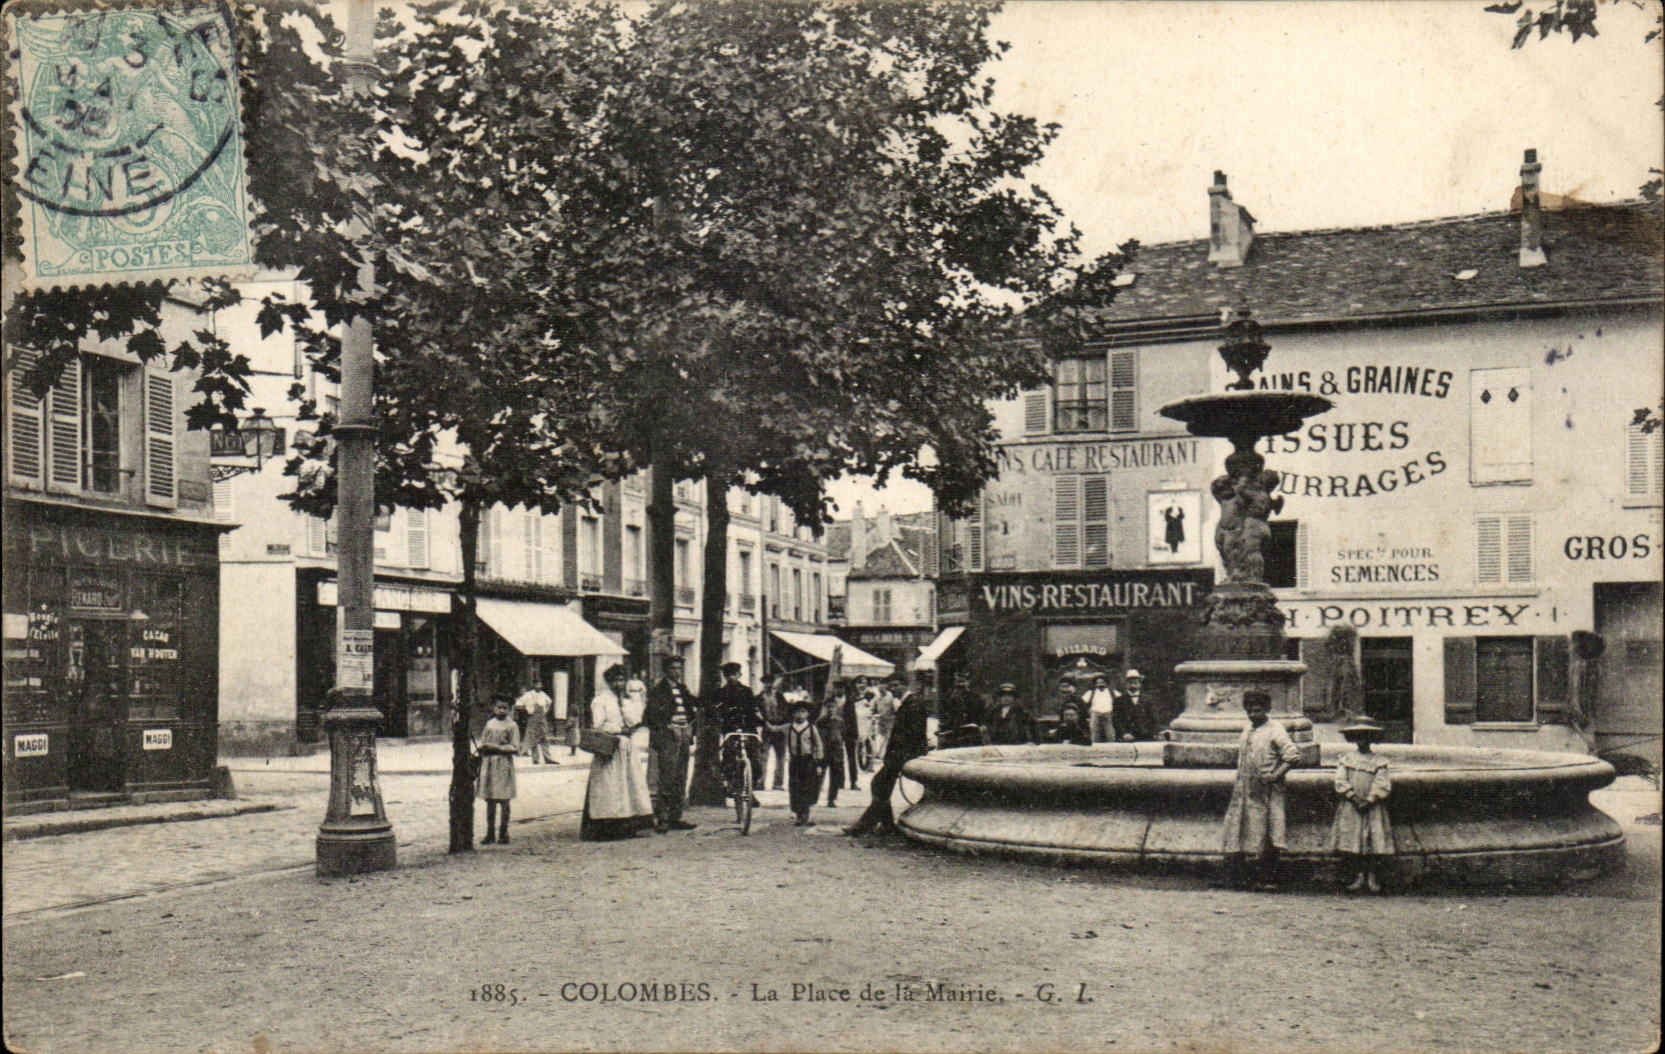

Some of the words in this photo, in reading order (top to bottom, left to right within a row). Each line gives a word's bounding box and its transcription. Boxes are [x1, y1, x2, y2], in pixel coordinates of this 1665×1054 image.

[96, 242, 187, 269] POSTES
[1320, 371, 1341, 395] &
[1347, 366, 1453, 398] GRAINES
[1085, 440, 1199, 469] RESTAURANT
[1391, 547, 1434, 559] POUR
[1564, 534, 1650, 560] GROS
[1331, 563, 1439, 583] SEMENCES
[1316, 604, 1530, 629] POITREY
[17, 738, 47, 752] MAGGI
[145, 733, 171, 745] MAGGI
